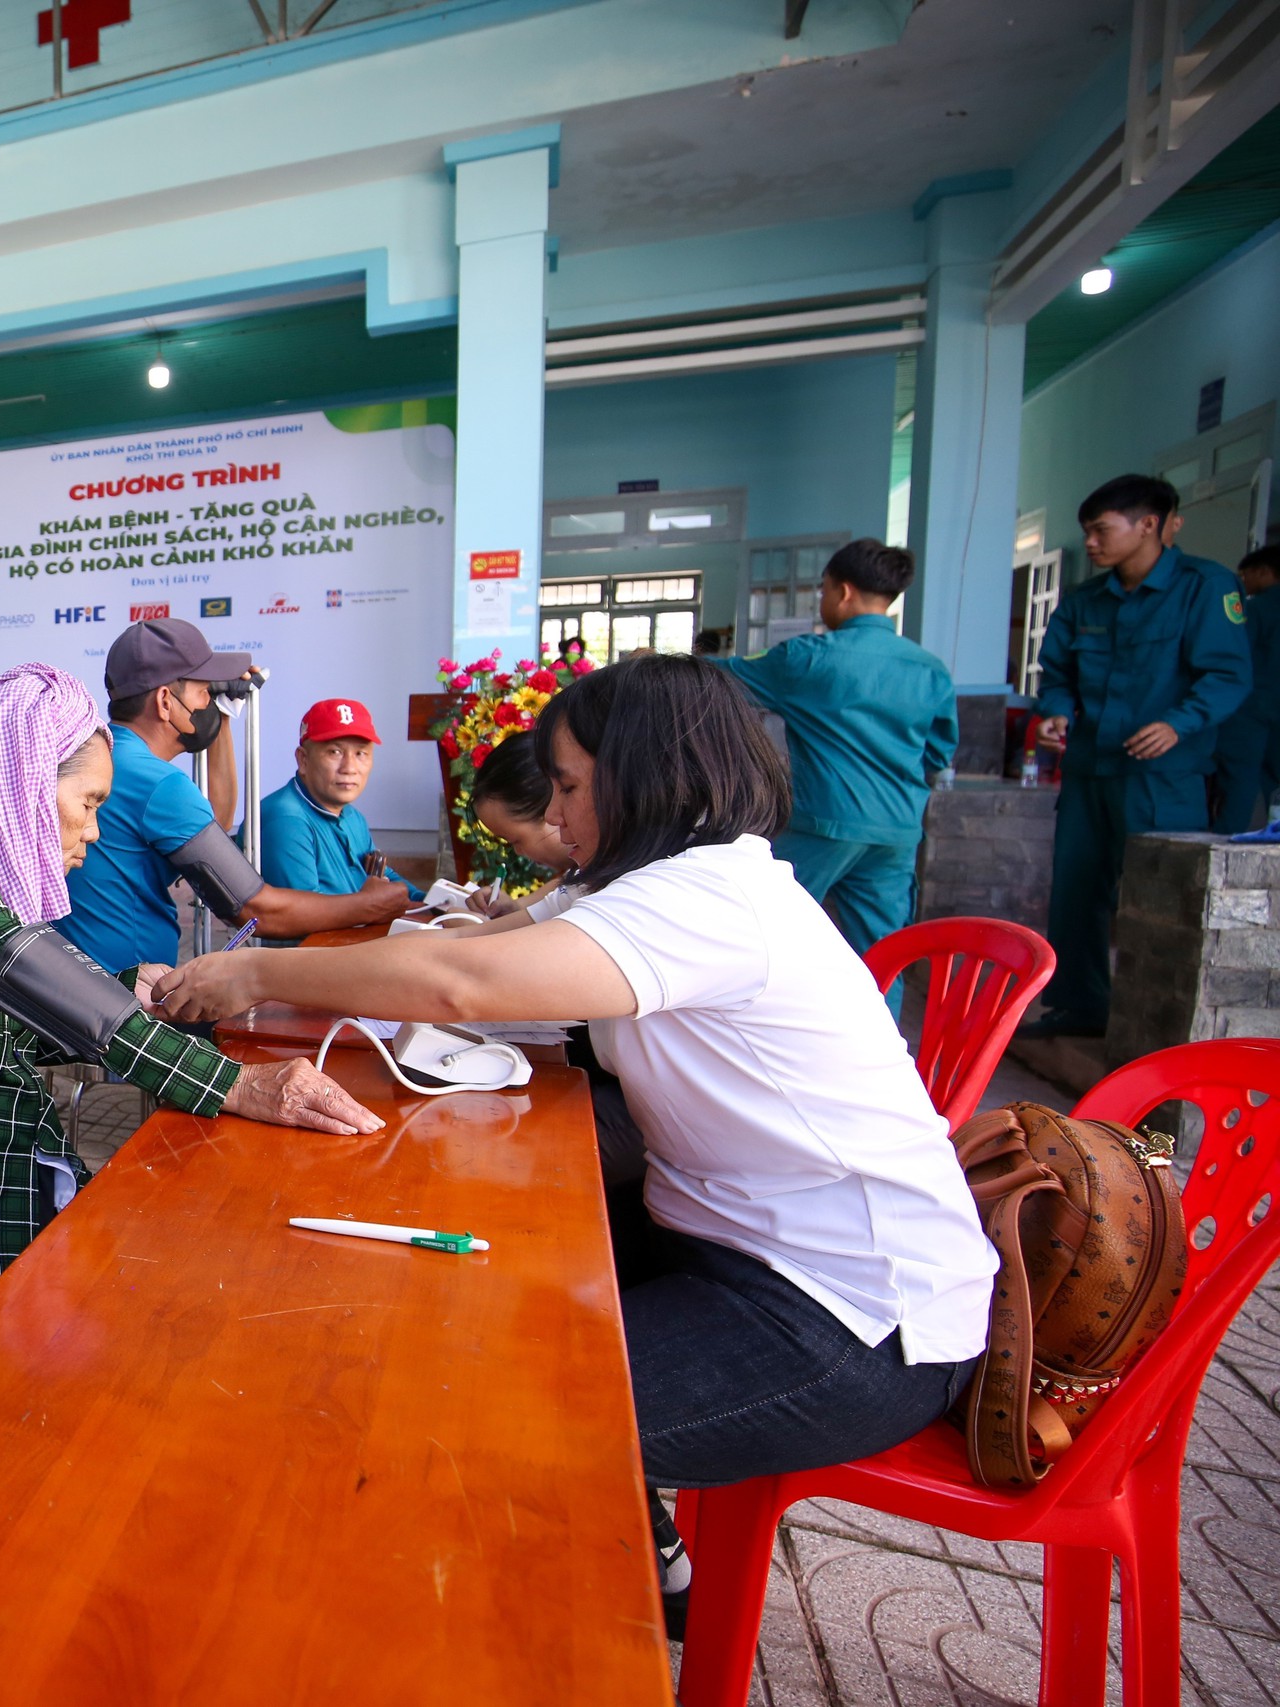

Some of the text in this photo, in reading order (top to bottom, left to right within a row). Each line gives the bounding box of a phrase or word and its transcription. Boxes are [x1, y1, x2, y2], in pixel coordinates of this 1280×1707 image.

[68, 451, 91, 461] BAN
[93, 445, 125, 457] NHÂN
[127, 441, 152, 453] DÂN
[155, 436, 194, 449] THÀNH
[247, 426, 268, 439] CHÍ
[271, 423, 304, 435] MINH
[157, 449, 175, 460] THI
[178, 446, 203, 458] ĐUA
[206, 444, 218, 455] 10
[69, 461, 281, 501] CHƯƠNG TRÌNH
[30, 538, 83, 557] ĐÌNH
[88, 531, 158, 552] CHÍNH
[164, 524, 234, 545] SÁCH,
[240, 517, 276, 540] HỘ
[283, 513, 336, 538] CẬN
[344, 505, 445, 530] NGHÈO,
[39, 515, 102, 536] KHÁM
[108, 509, 170, 531] BỆNH
[190, 501, 255, 524] TẶNG
[261, 492, 317, 517] QUÀ
[9, 534, 354, 581] HỘ CÓ HOÀN CẢNH KHÓ KHĂN
[131, 574, 210, 587] Đơn vị tài trợ
[258, 606, 300, 615] LIKSIN
[239, 641, 263, 651] 2026
